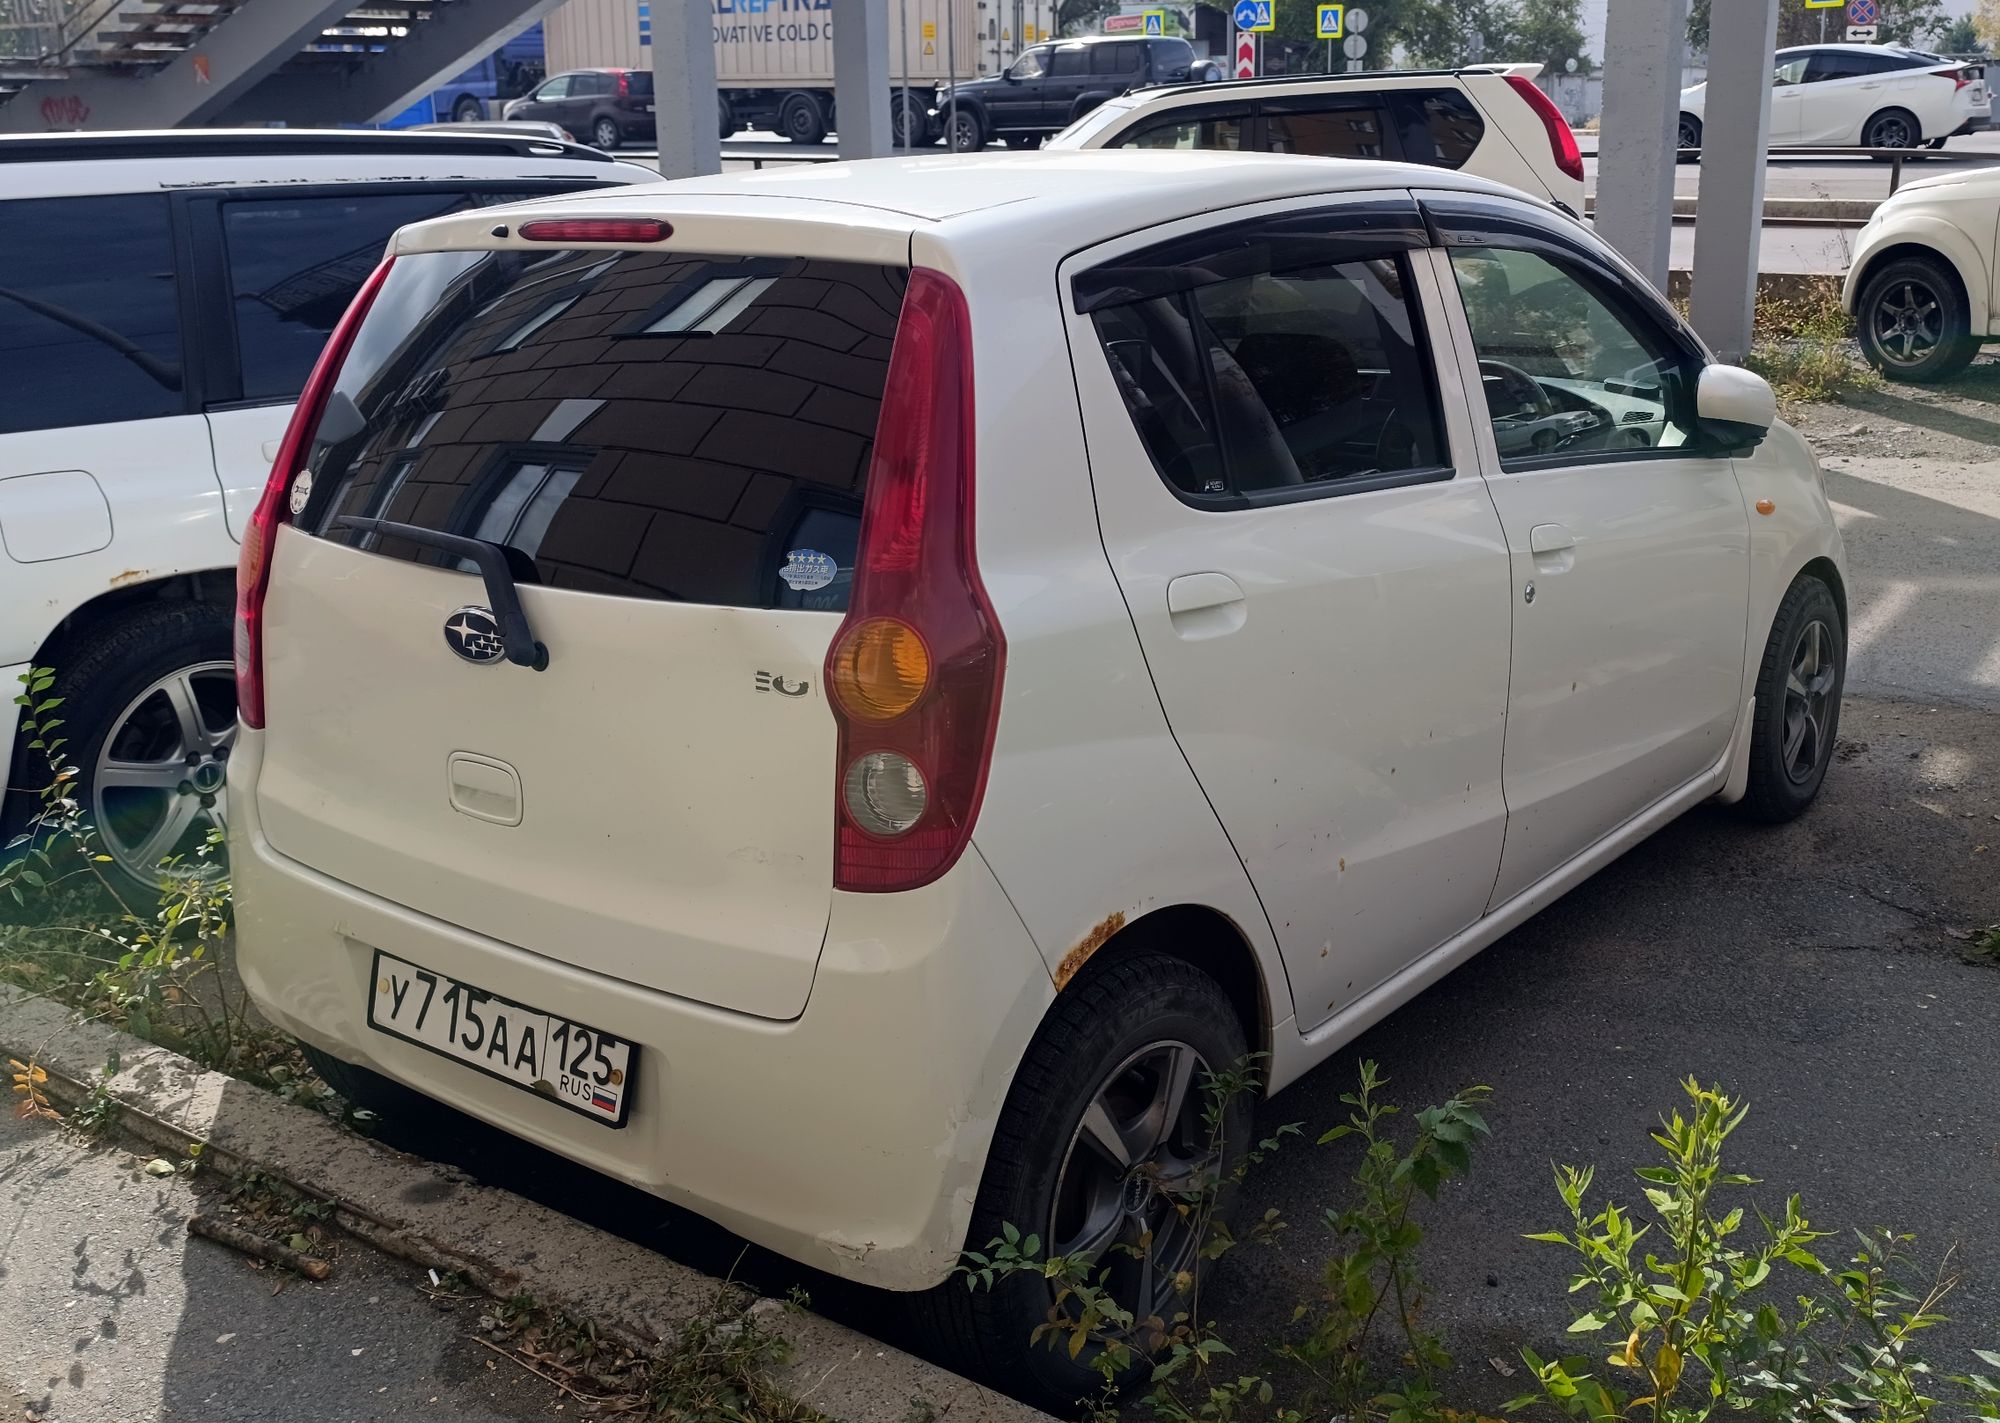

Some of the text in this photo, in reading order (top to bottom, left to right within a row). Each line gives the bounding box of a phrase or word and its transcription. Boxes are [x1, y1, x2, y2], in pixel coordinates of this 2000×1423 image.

[777, 23, 819, 41] COLD
[553, 1021, 616, 1086] 125
[559, 1074, 592, 1102] RUS
